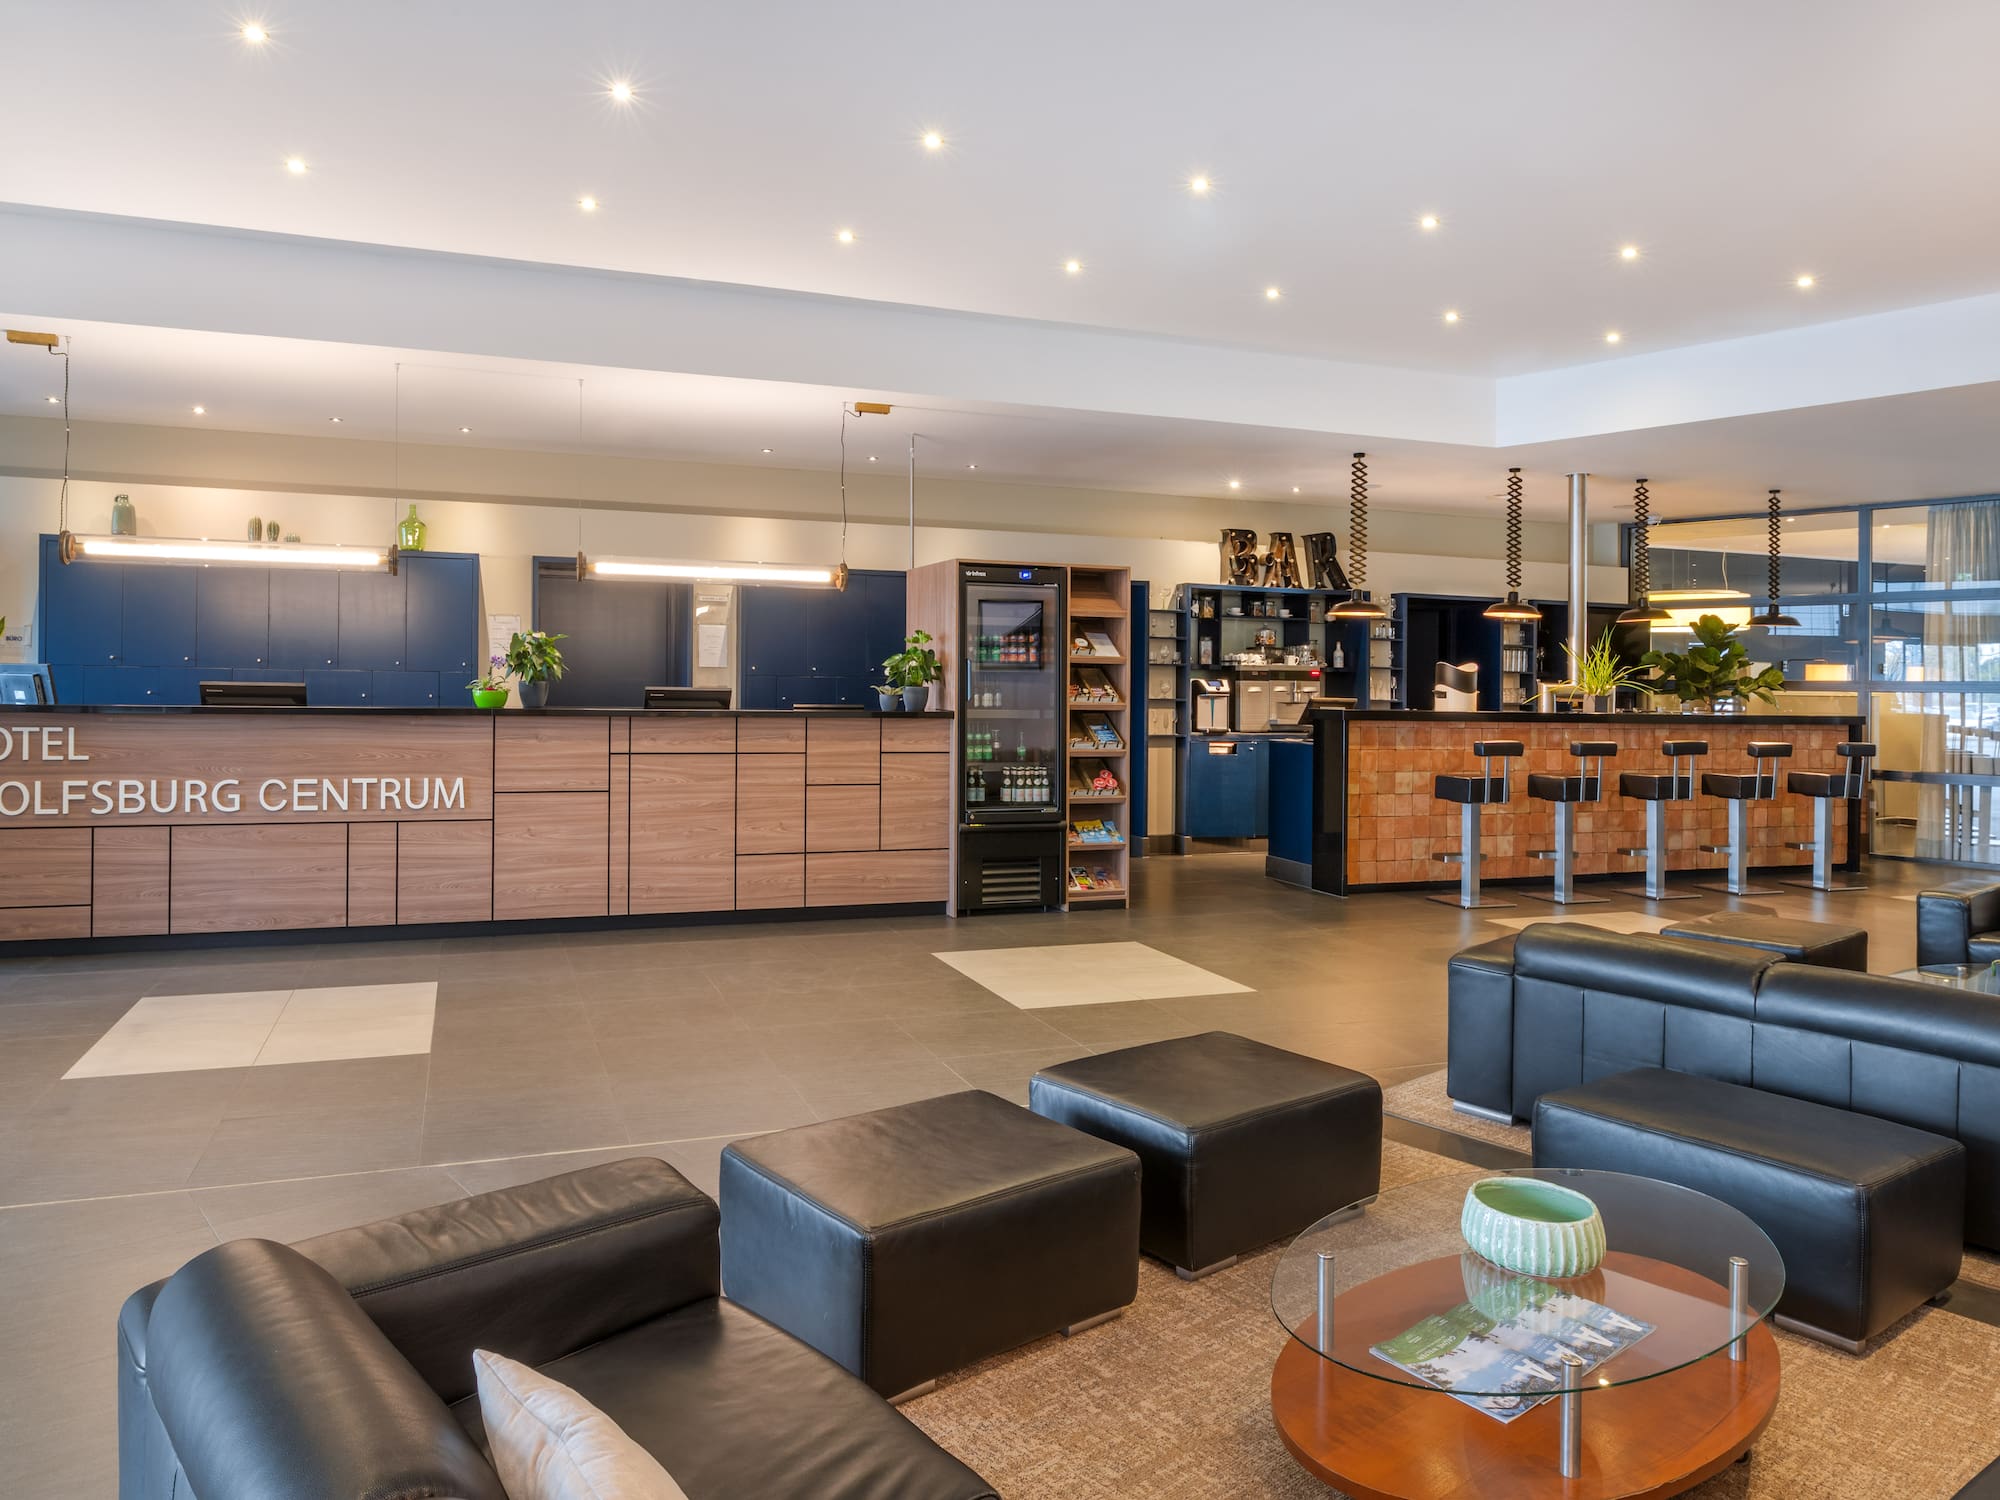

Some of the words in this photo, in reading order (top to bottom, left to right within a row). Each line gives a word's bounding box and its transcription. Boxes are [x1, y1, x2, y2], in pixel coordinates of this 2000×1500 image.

[1219, 528, 1353, 590] BAR
[0, 779, 241, 816] OLFSBURG
[258, 776, 466, 813] CENTRUM
